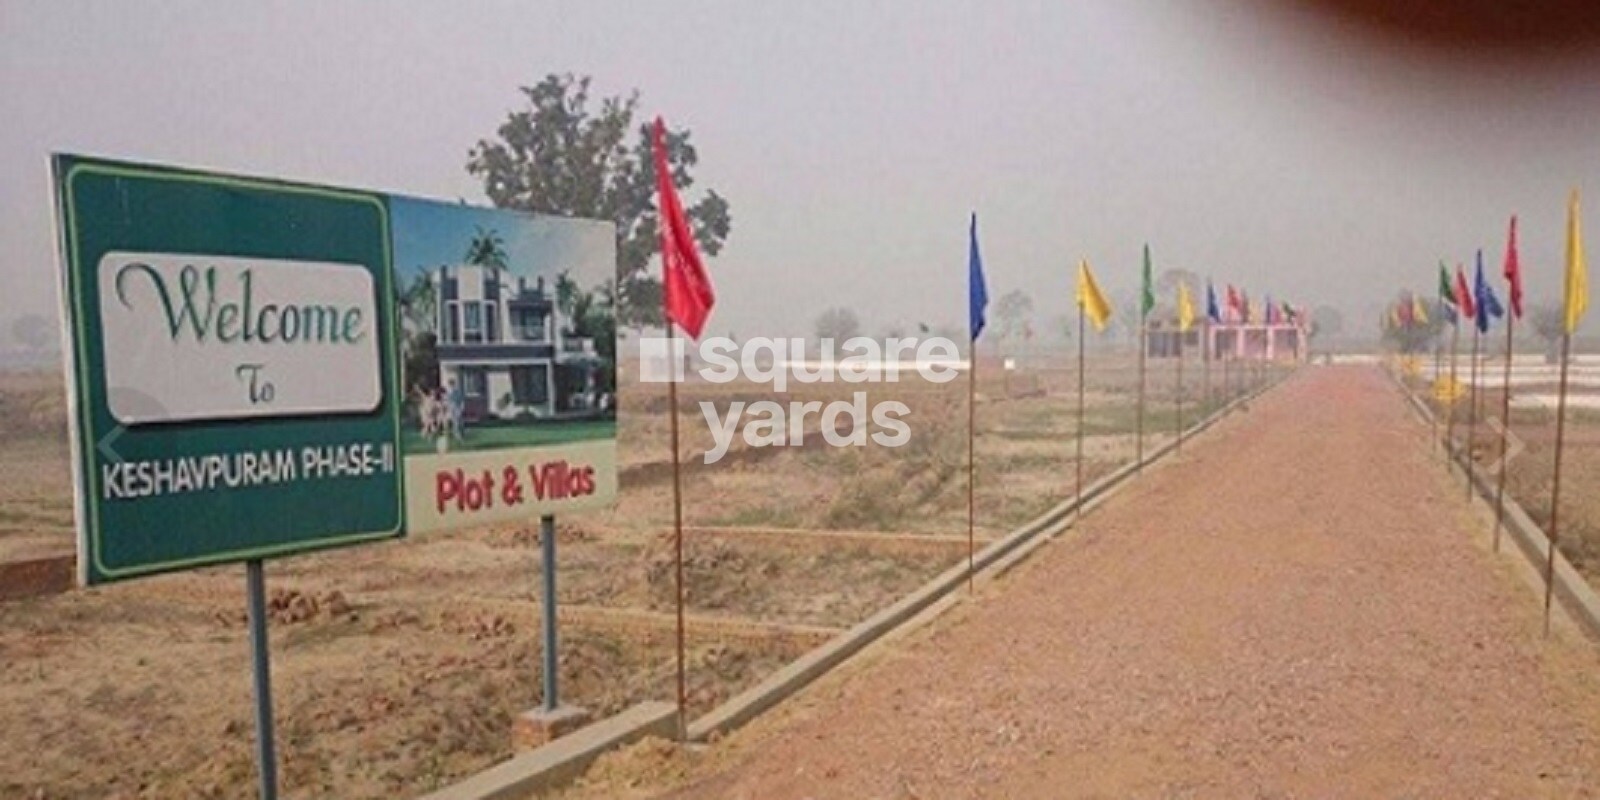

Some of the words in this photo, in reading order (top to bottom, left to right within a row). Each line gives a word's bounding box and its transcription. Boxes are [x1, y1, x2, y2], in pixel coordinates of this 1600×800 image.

[115, 262, 366, 345] Welcome
[236, 364, 275, 404] To
[103, 450, 296, 499] KESHAVPURAM
[303, 443, 394, 479] PHASE-II
[436, 468, 494, 514] Plot
[502, 464, 524, 506] &
[529, 460, 595, 501] Villas
